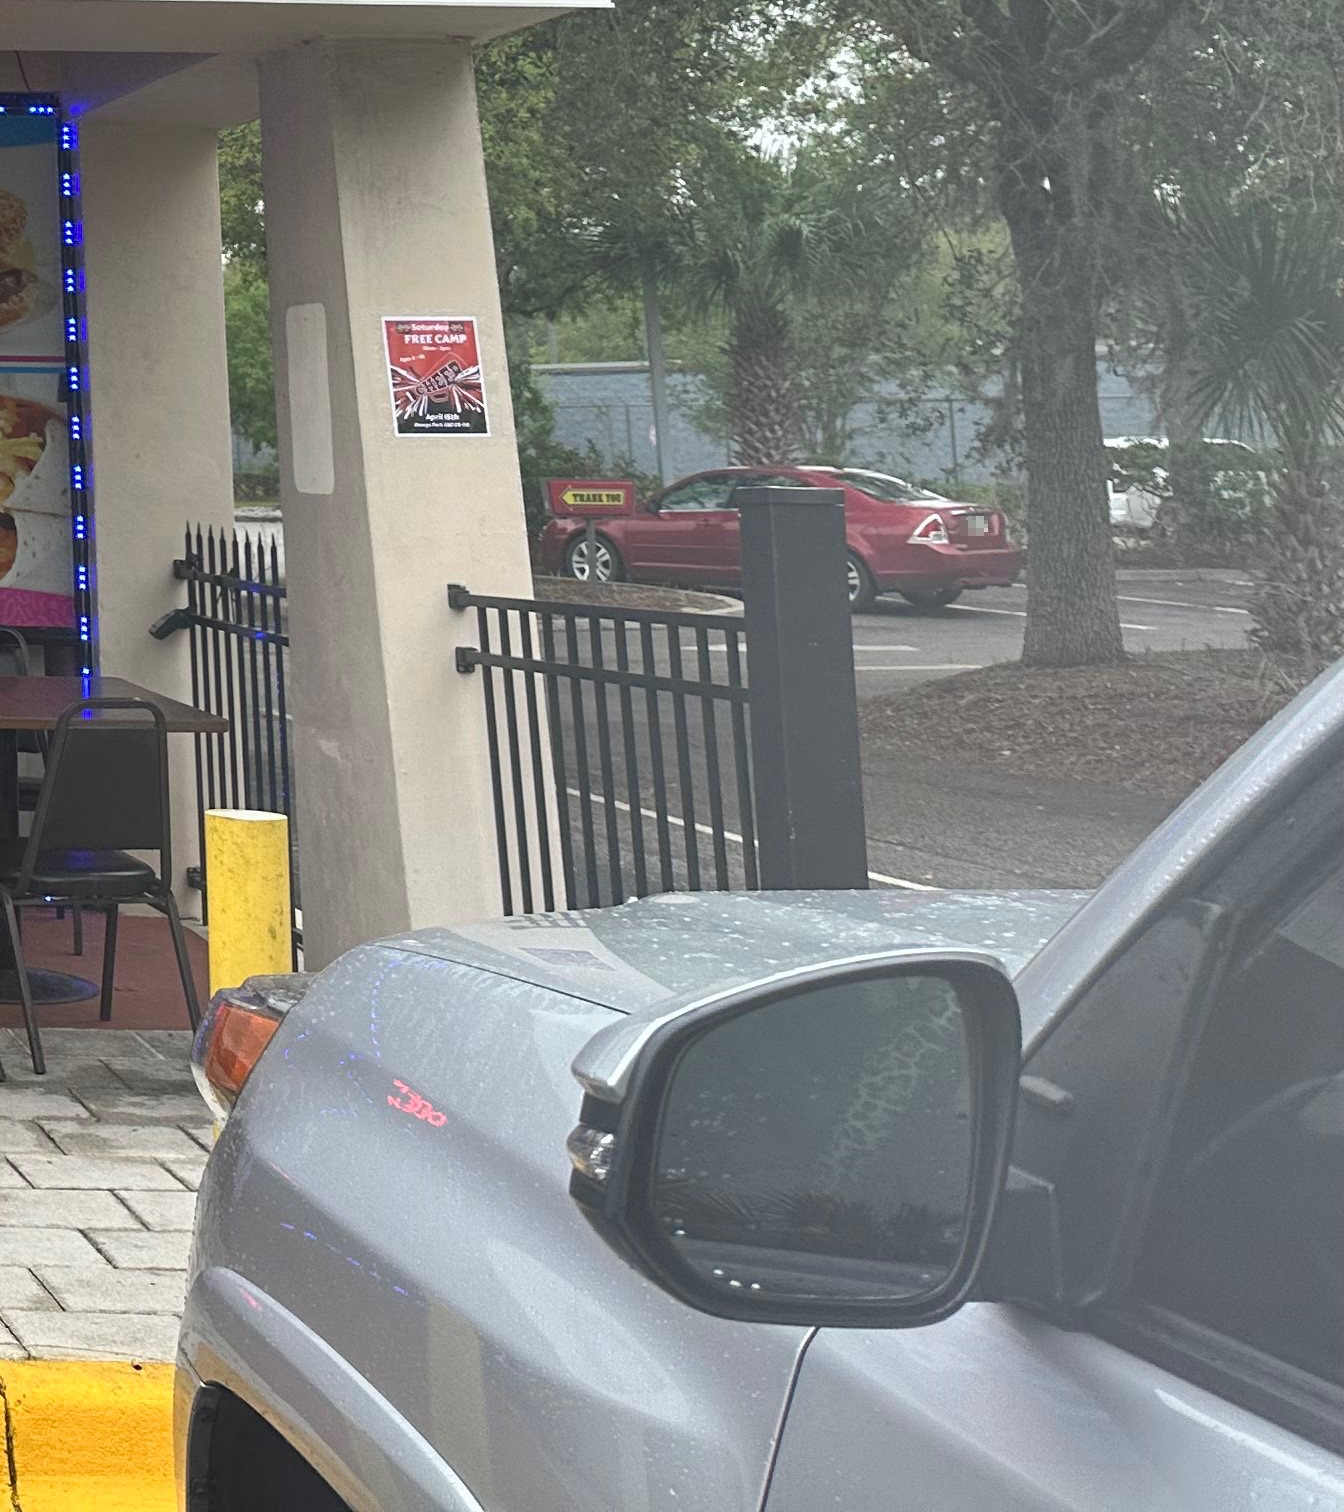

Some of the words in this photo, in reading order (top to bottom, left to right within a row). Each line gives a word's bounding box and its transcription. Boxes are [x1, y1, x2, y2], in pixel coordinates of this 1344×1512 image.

[411, 323, 450, 333] Saturday
[404, 334, 433, 344] FREE
[434, 334, 468, 344] CAMP
[572, 493, 603, 503] THANK
